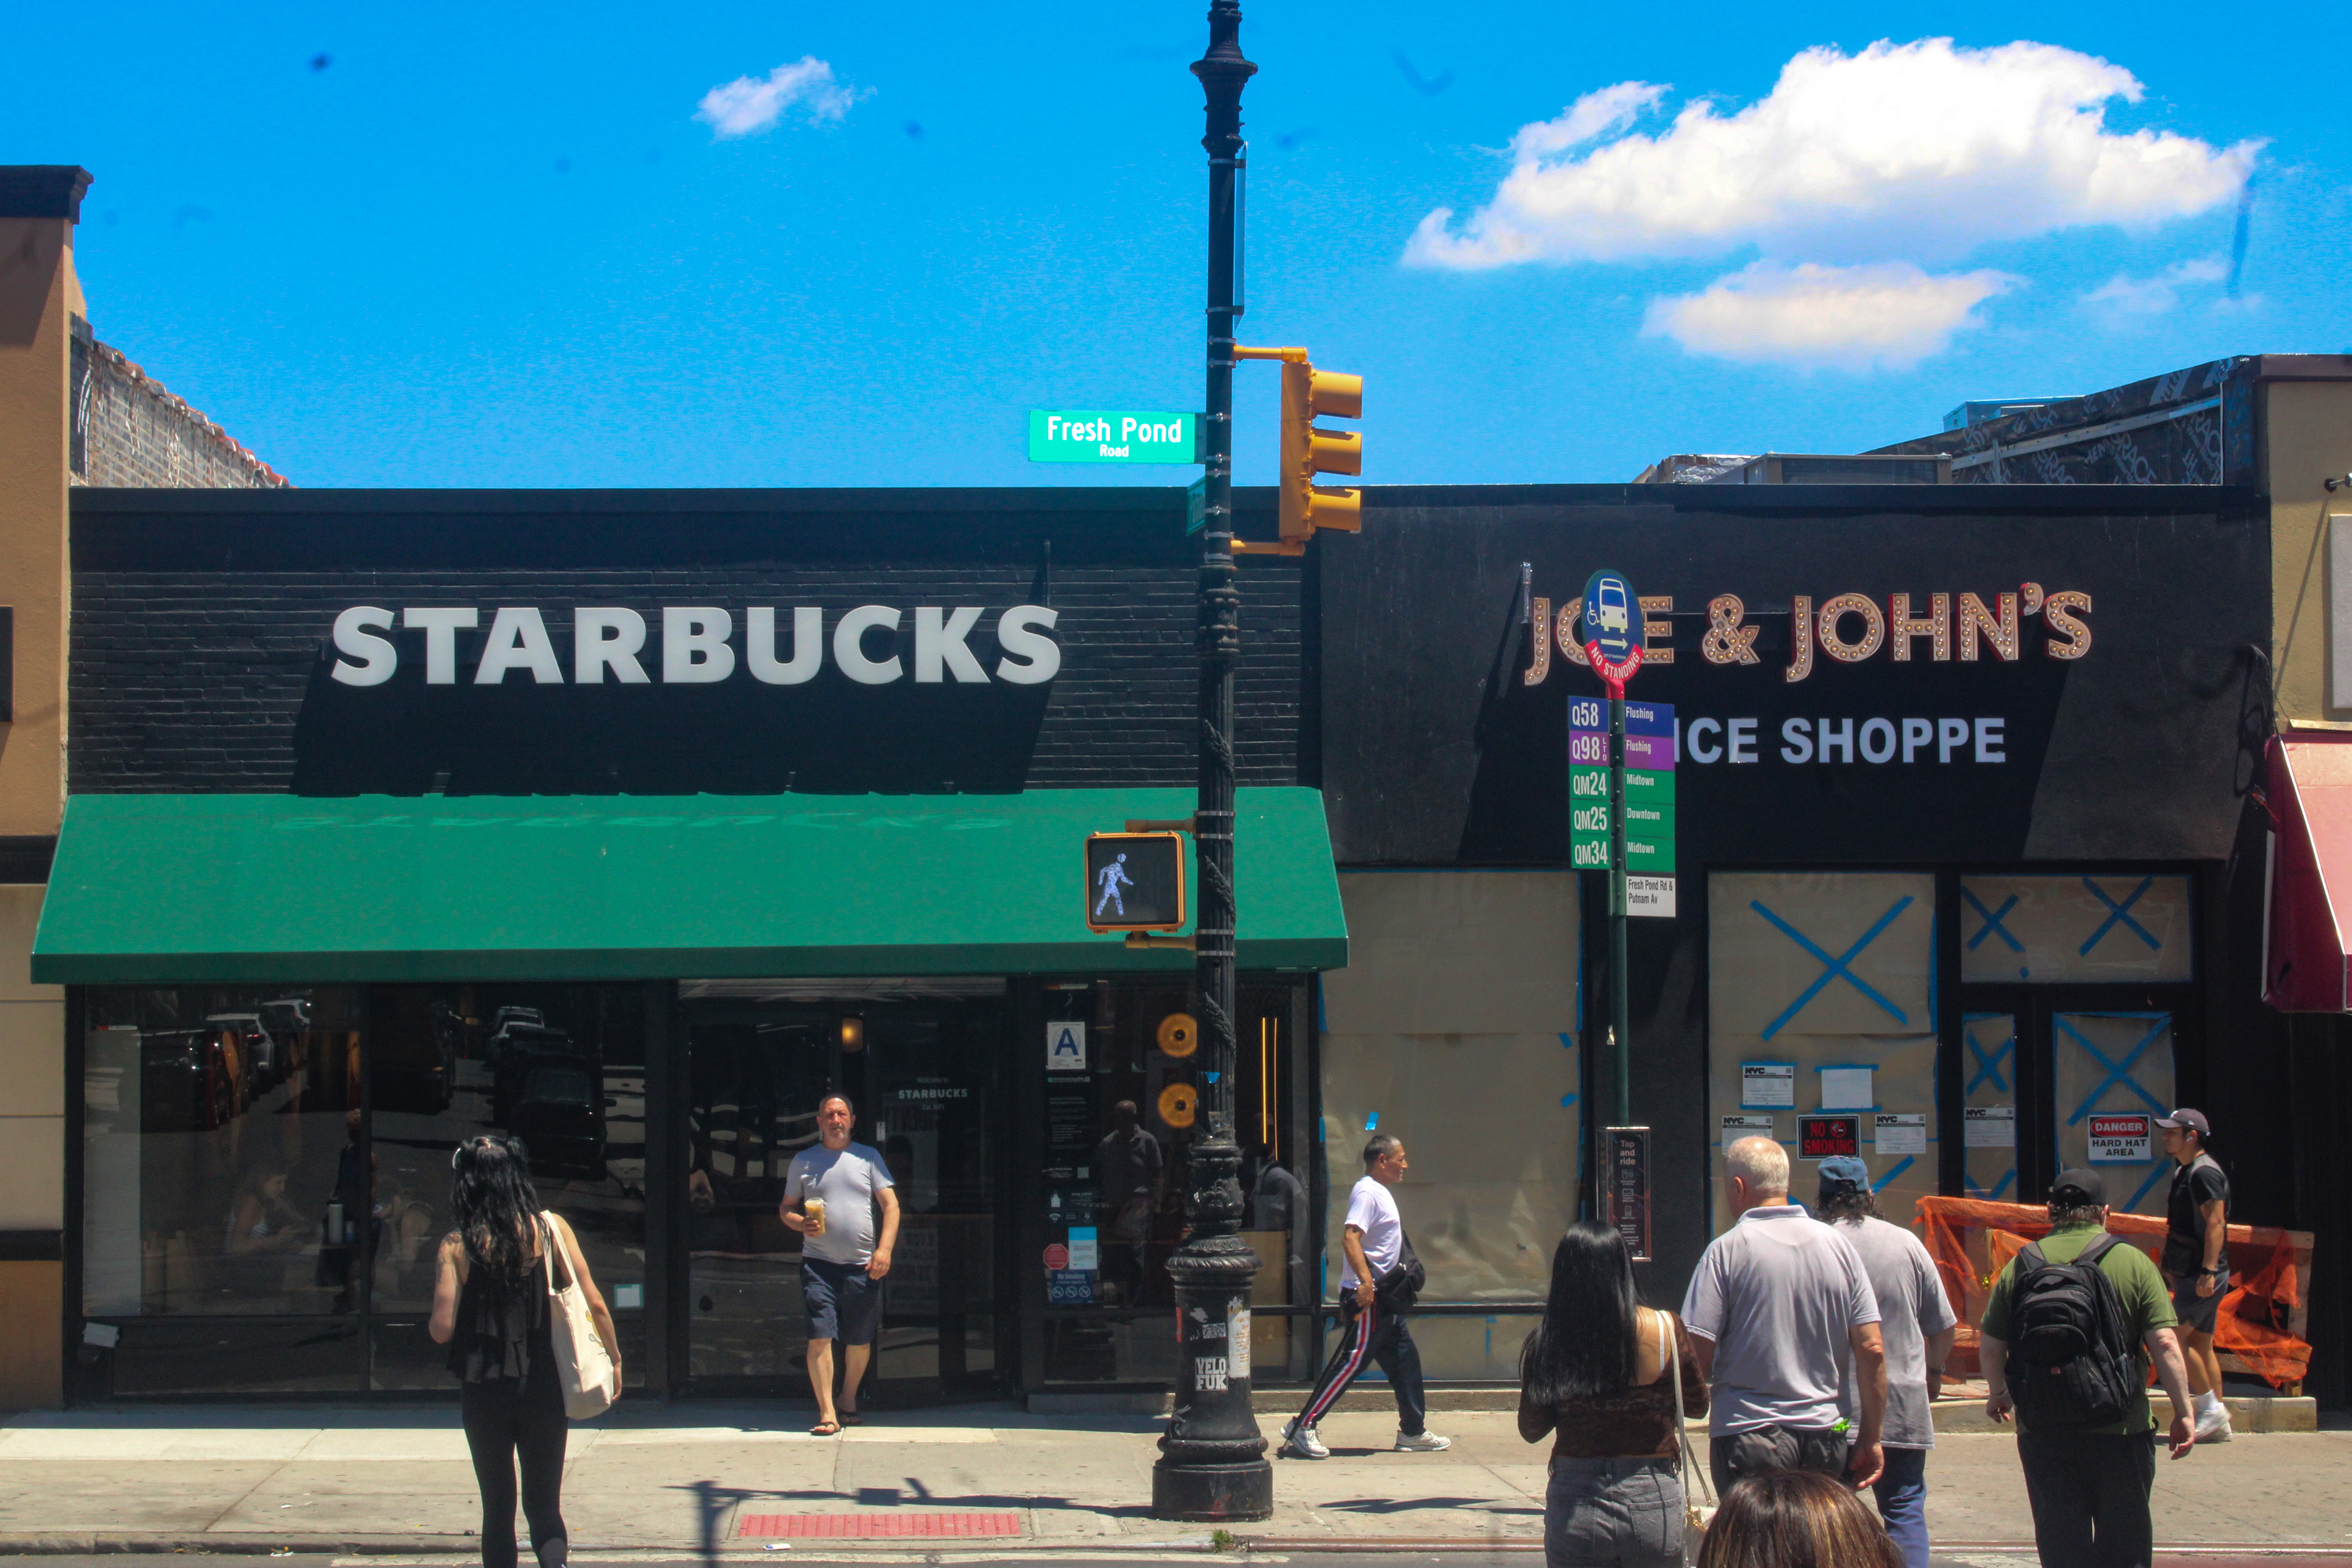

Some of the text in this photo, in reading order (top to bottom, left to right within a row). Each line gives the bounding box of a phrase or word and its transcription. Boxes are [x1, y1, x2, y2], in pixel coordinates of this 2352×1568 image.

[1047, 416, 1181, 443] Fresh Pond
[1100, 444, 1129, 457] Road
[1706, 593, 1761, 666] &
[1782, 582, 2092, 684] JOHN'S
[332, 605, 1062, 687] STARBUCKS
[1591, 646, 1640, 679] NO STANDING
[1572, 702, 1599, 727] Q58
[1626, 706, 1654, 722] Flushing
[1572, 735, 1601, 761] Q98
[1626, 739, 1651, 755] Flushing
[1780, 716, 2006, 765] SHOPPE
[1573, 771, 1607, 796] QM24
[1626, 773, 1655, 786] Midtown
[1574, 806, 1608, 831] QM25
[1627, 807, 1661, 820] Downtown
[1575, 840, 1608, 865] QM34
[1627, 841, 1655, 855] Midtown
[1628, 878, 1673, 891] Fresh Pond Rd &
[1628, 892, 1658, 904] Putnam Av
[1054, 1028, 1079, 1056] A
[898, 1088, 968, 1099] STARBUCKS
[1810, 1122, 1826, 1137] NO
[2094, 1122, 2143, 1132] DANGER
[1621, 1140, 1635, 1148] Tap
[1804, 1138, 1855, 1154] SMOKING
[1196, 1357, 1226, 1374] YELO
[1197, 1374, 1227, 1389] FUK
